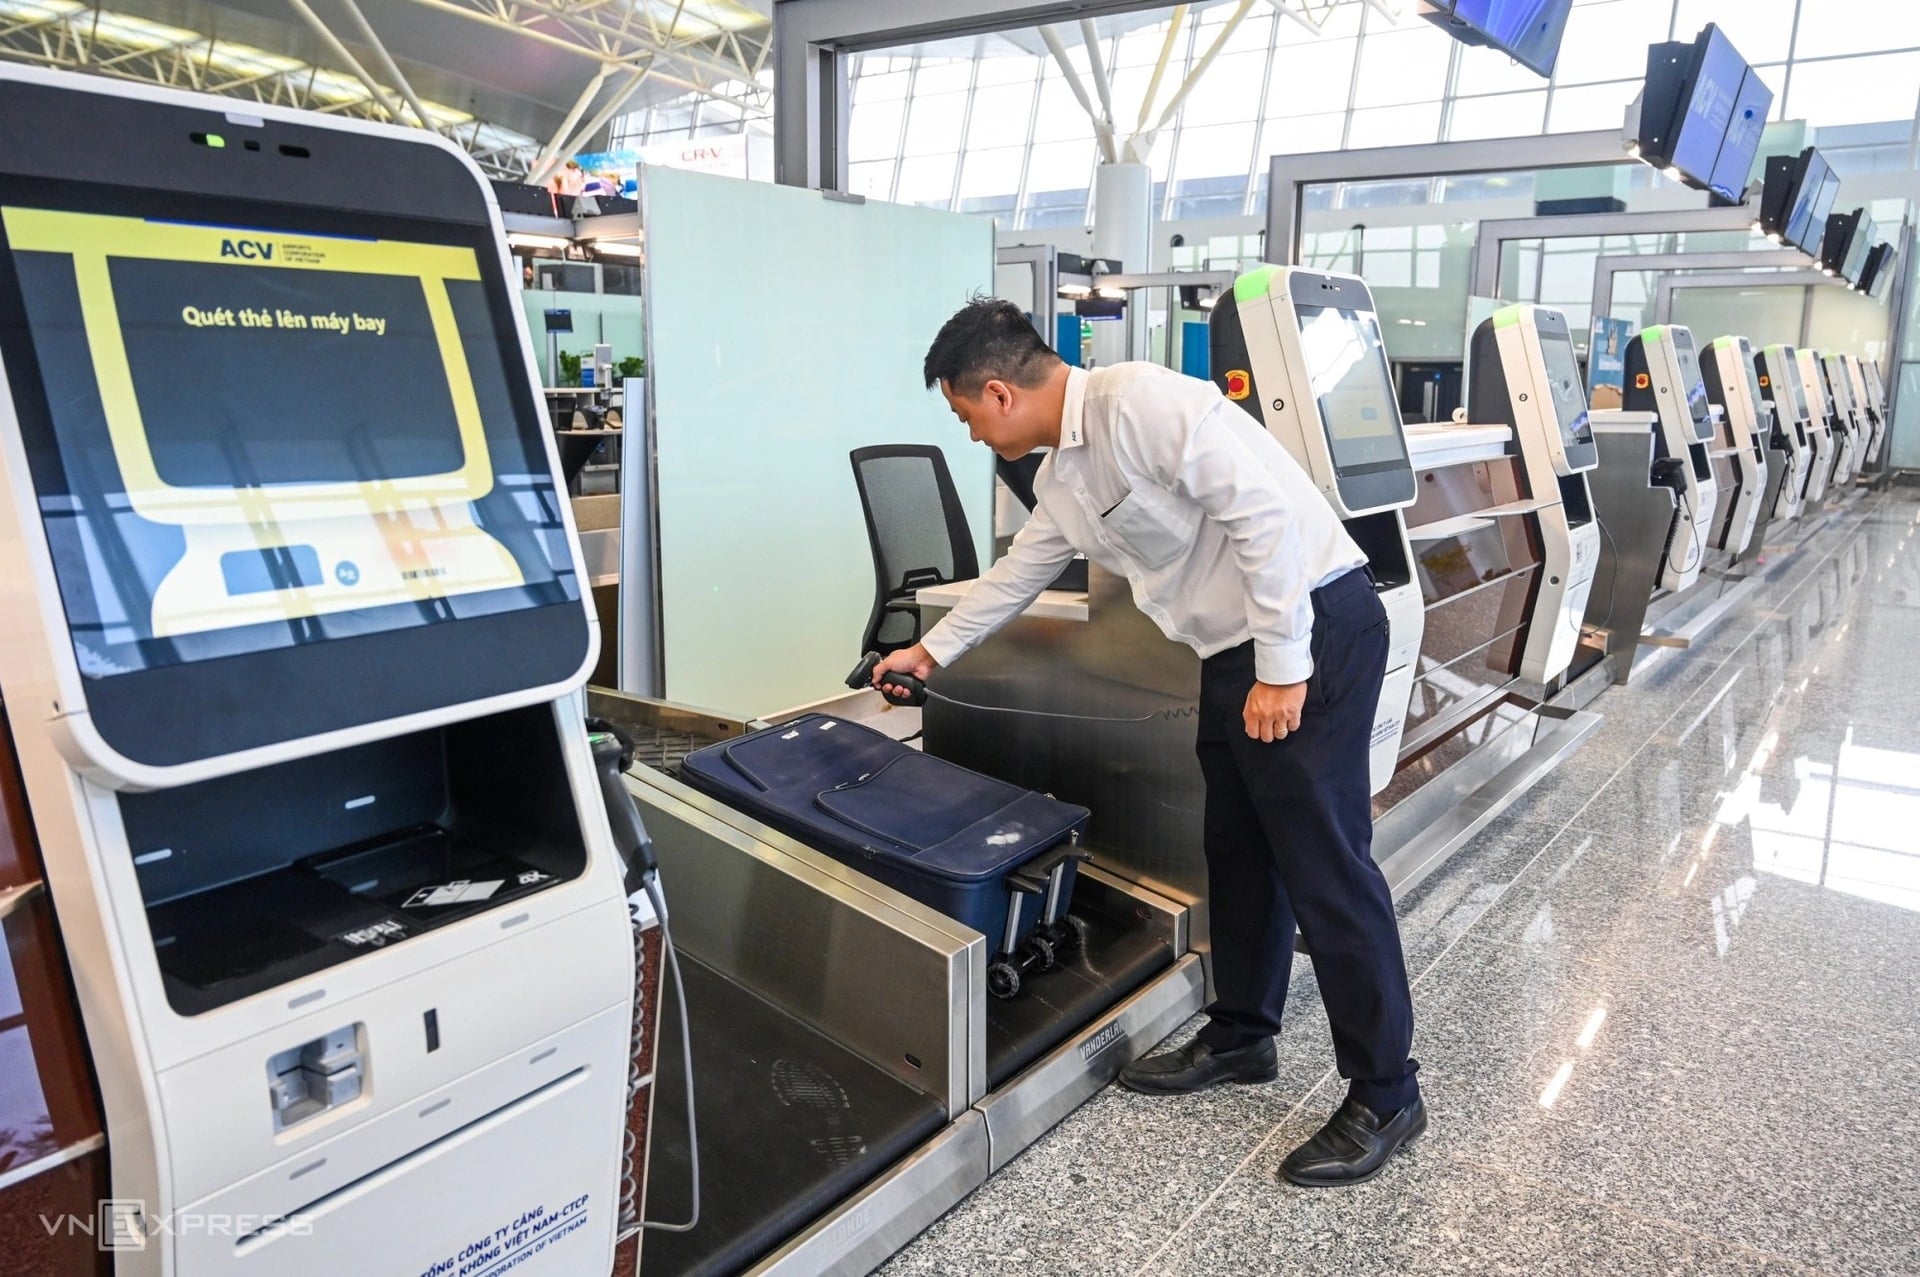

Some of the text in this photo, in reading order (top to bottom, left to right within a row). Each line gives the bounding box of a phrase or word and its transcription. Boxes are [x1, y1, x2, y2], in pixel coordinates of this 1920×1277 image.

[220, 239, 273, 260] ACV
[182, 305, 386, 336] Quét thẻ lên máy bay
[458, 1236, 492, 1262] CÔNG
[495, 1224, 509, 1241] TY
[512, 1205, 544, 1231] CẢNG
[458, 1194, 589, 1277] KHÔNG VIỆT NAM-CTCP
[484, 1216, 588, 1277] PORATION OF VIETNAM
